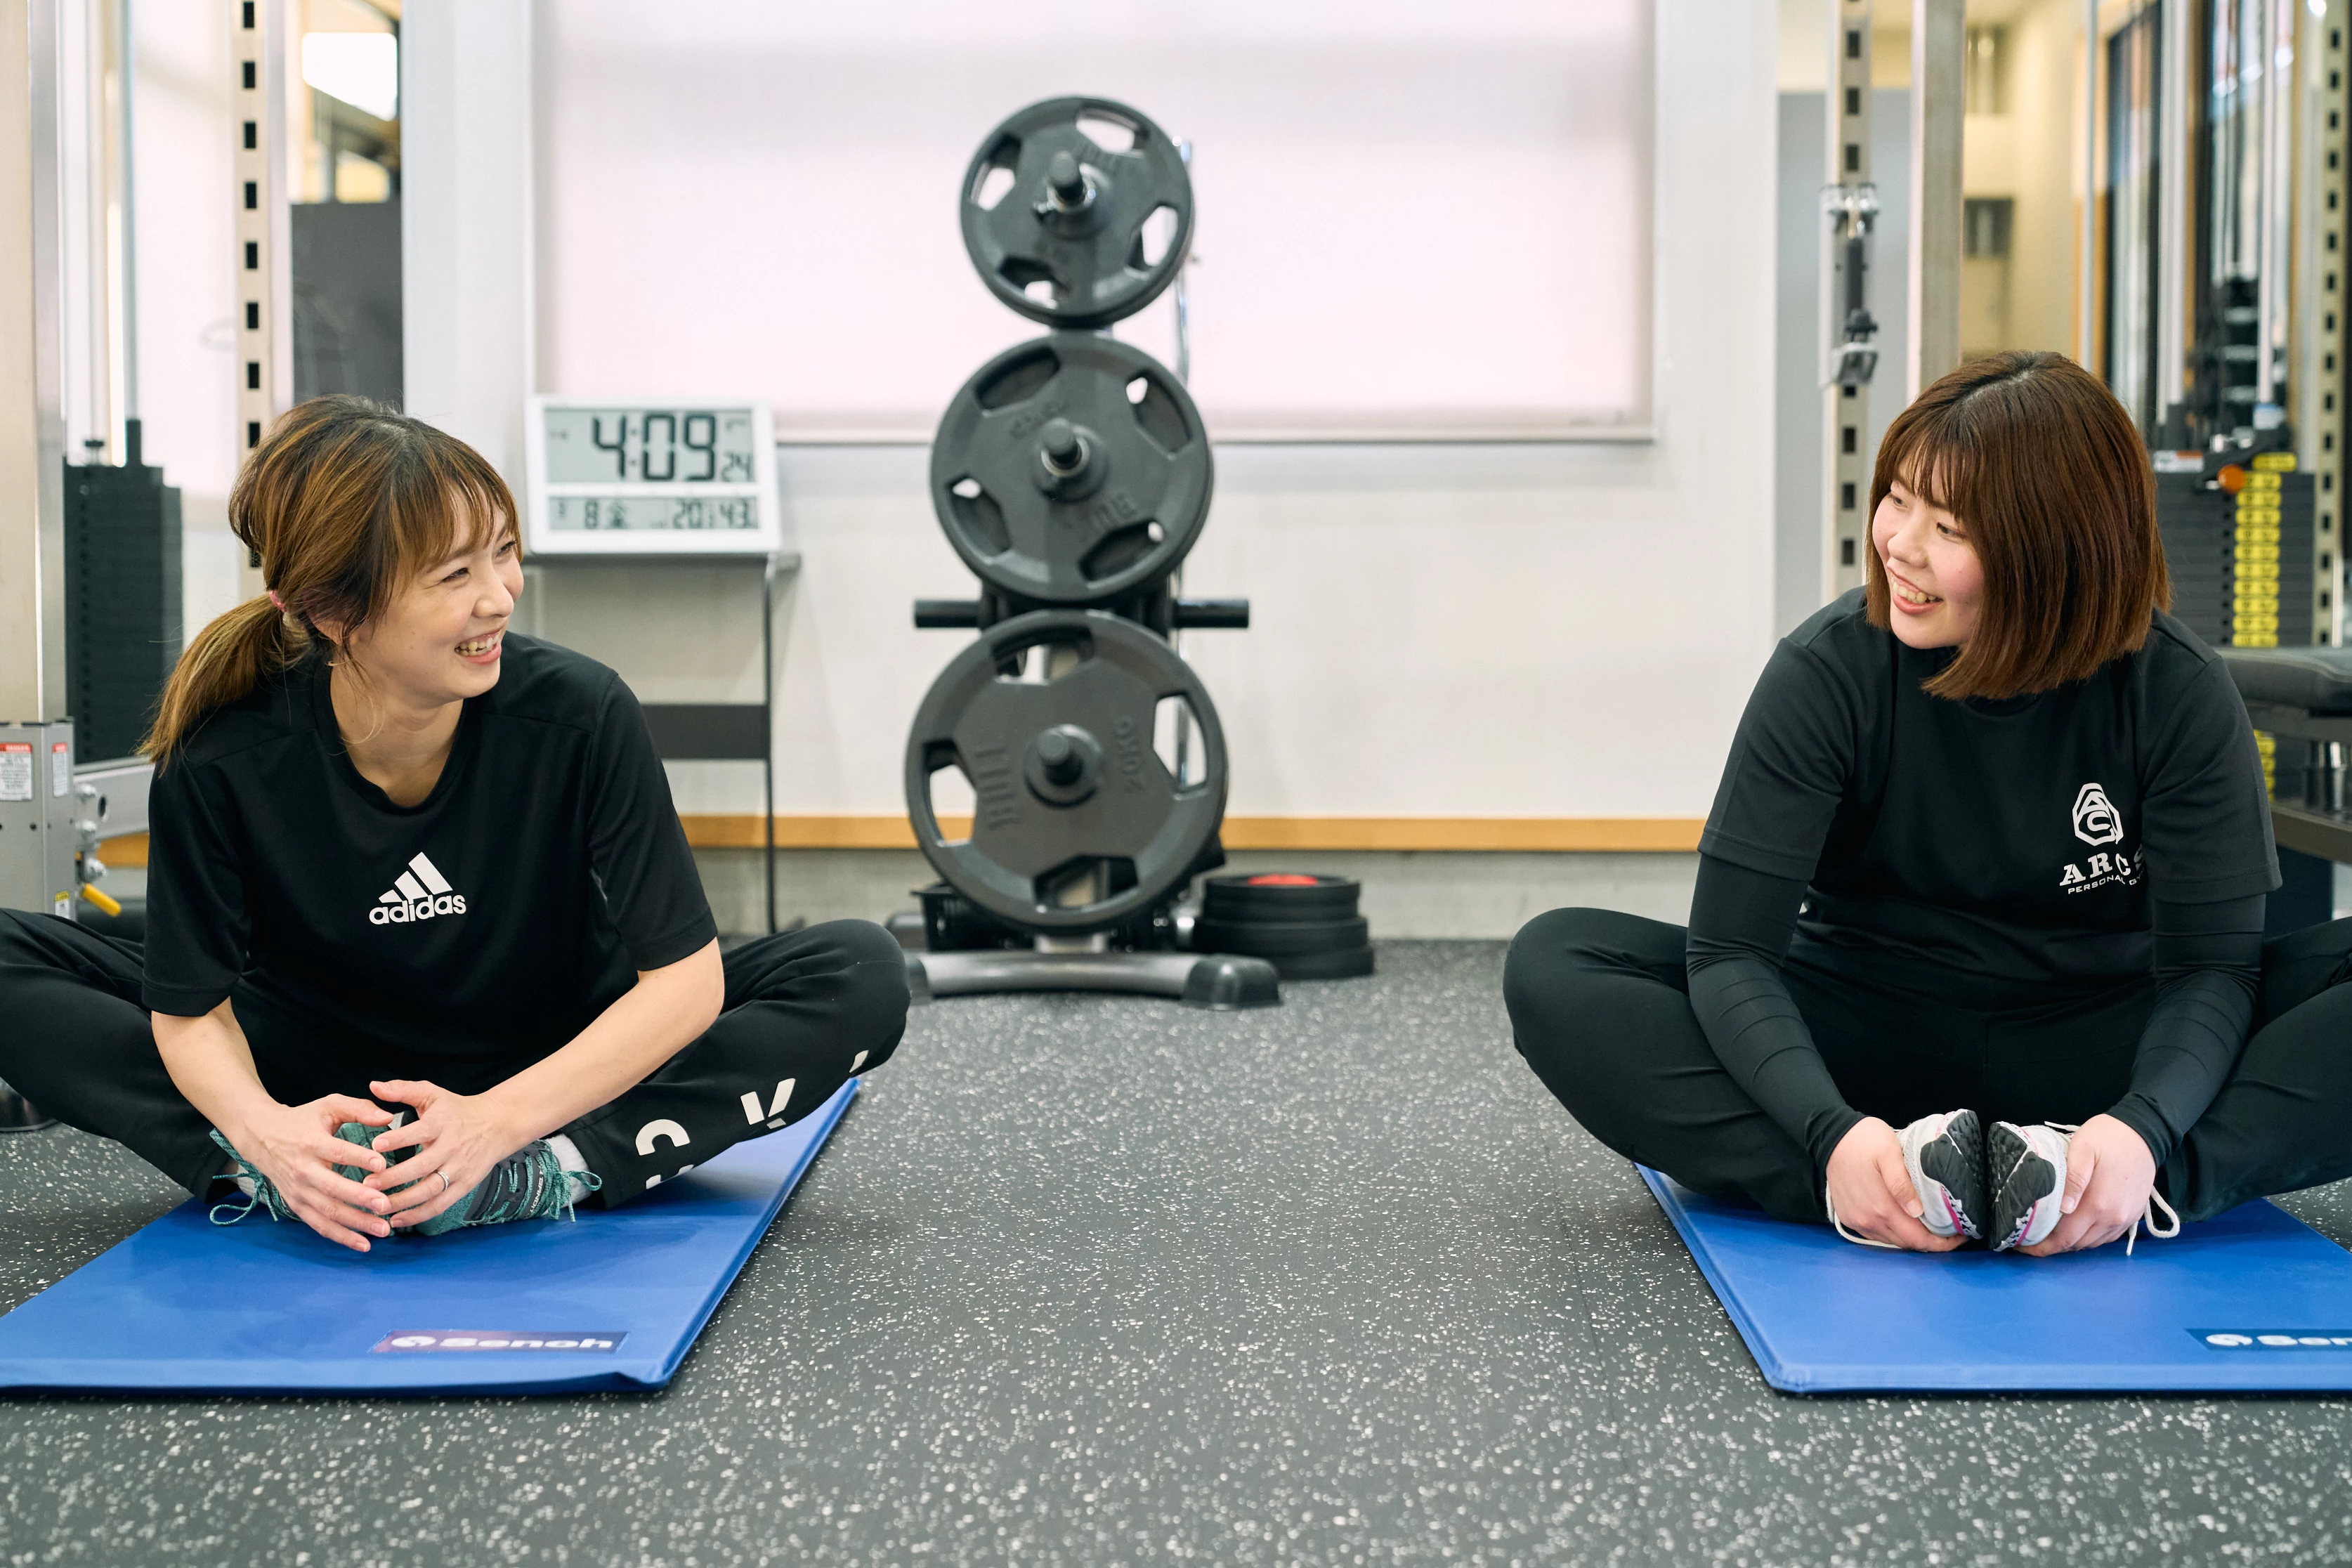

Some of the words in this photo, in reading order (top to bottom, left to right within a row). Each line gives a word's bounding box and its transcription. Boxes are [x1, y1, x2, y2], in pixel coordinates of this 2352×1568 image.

[592, 413, 717, 481] 4:09
[722, 452, 752, 483] 24
[2067, 874, 2126, 895] PERSONAL
[369, 894, 467, 925] adidas
[438, 1337, 613, 1350] Senoh
